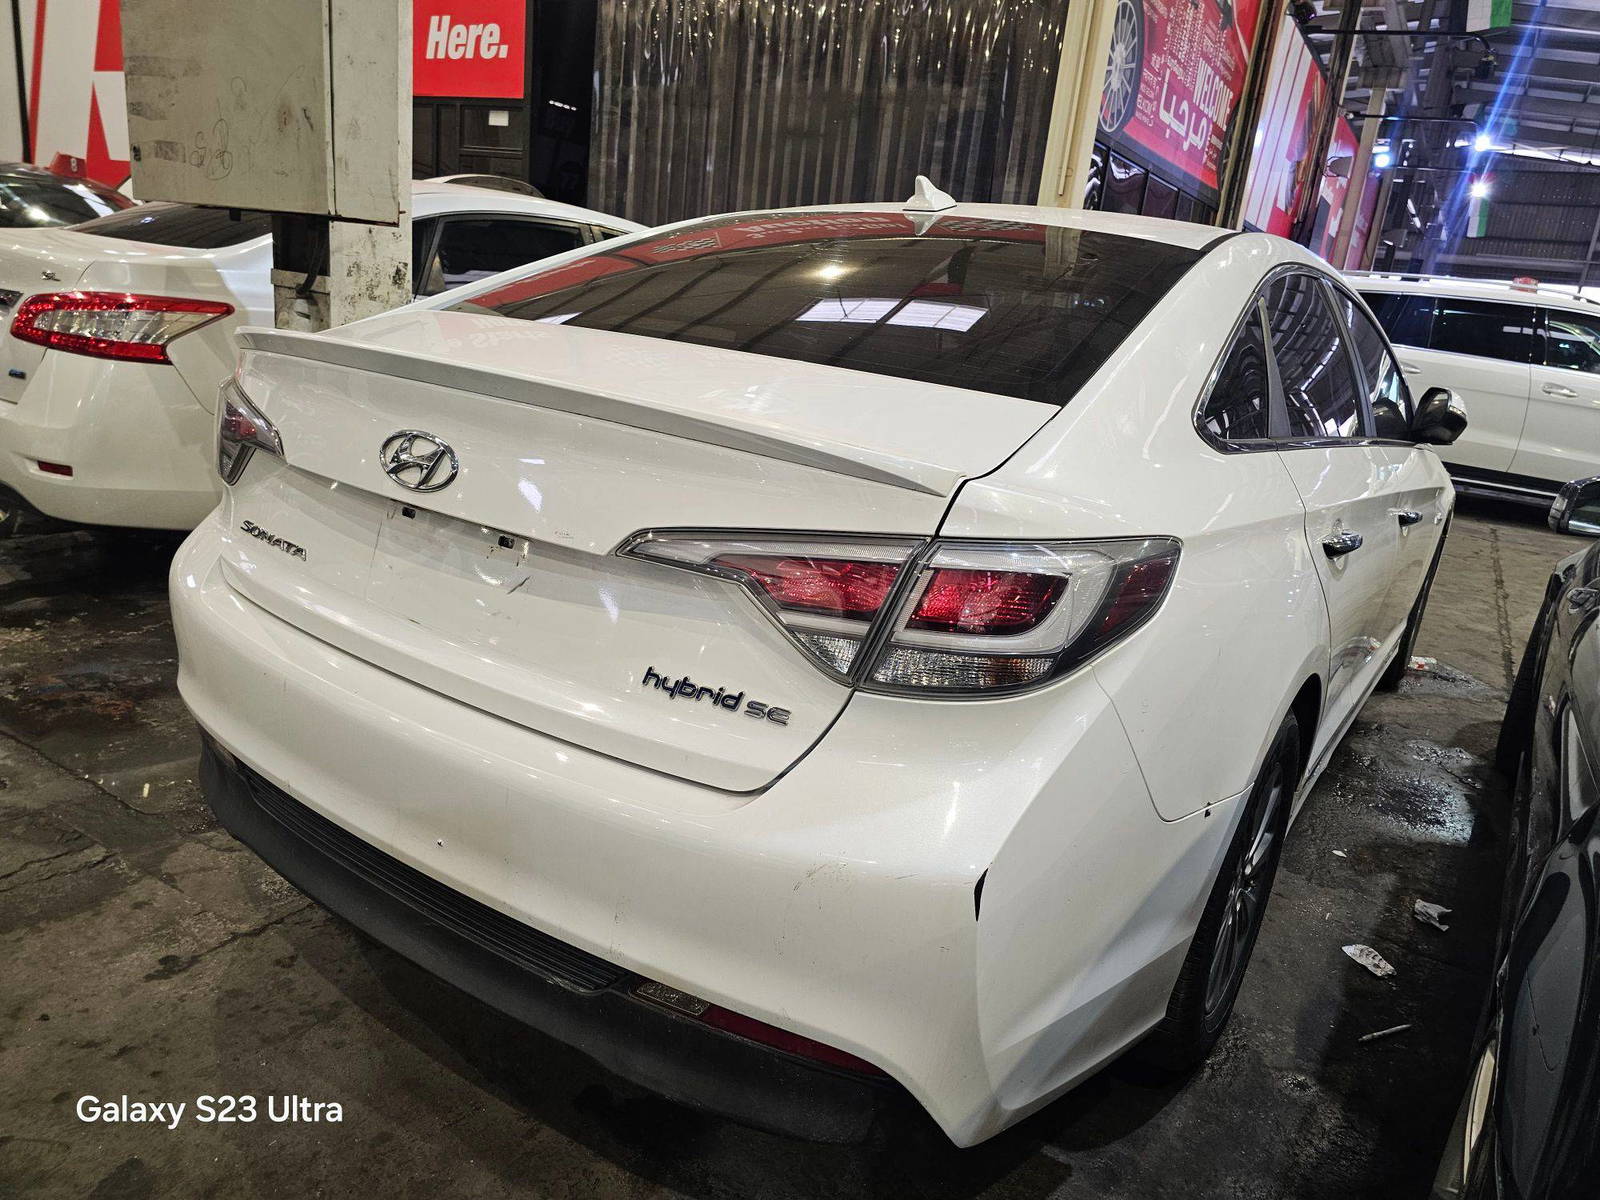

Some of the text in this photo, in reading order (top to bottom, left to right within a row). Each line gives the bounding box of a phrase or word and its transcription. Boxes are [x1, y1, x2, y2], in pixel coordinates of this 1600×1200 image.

[425, 15, 509, 60] Here.
[1159, 67, 1208, 152] مرحبا
[1193, 57, 1234, 132] WELCOME
[240, 520, 307, 561] SONATA
[642, 665, 793, 727] hybrid SE
